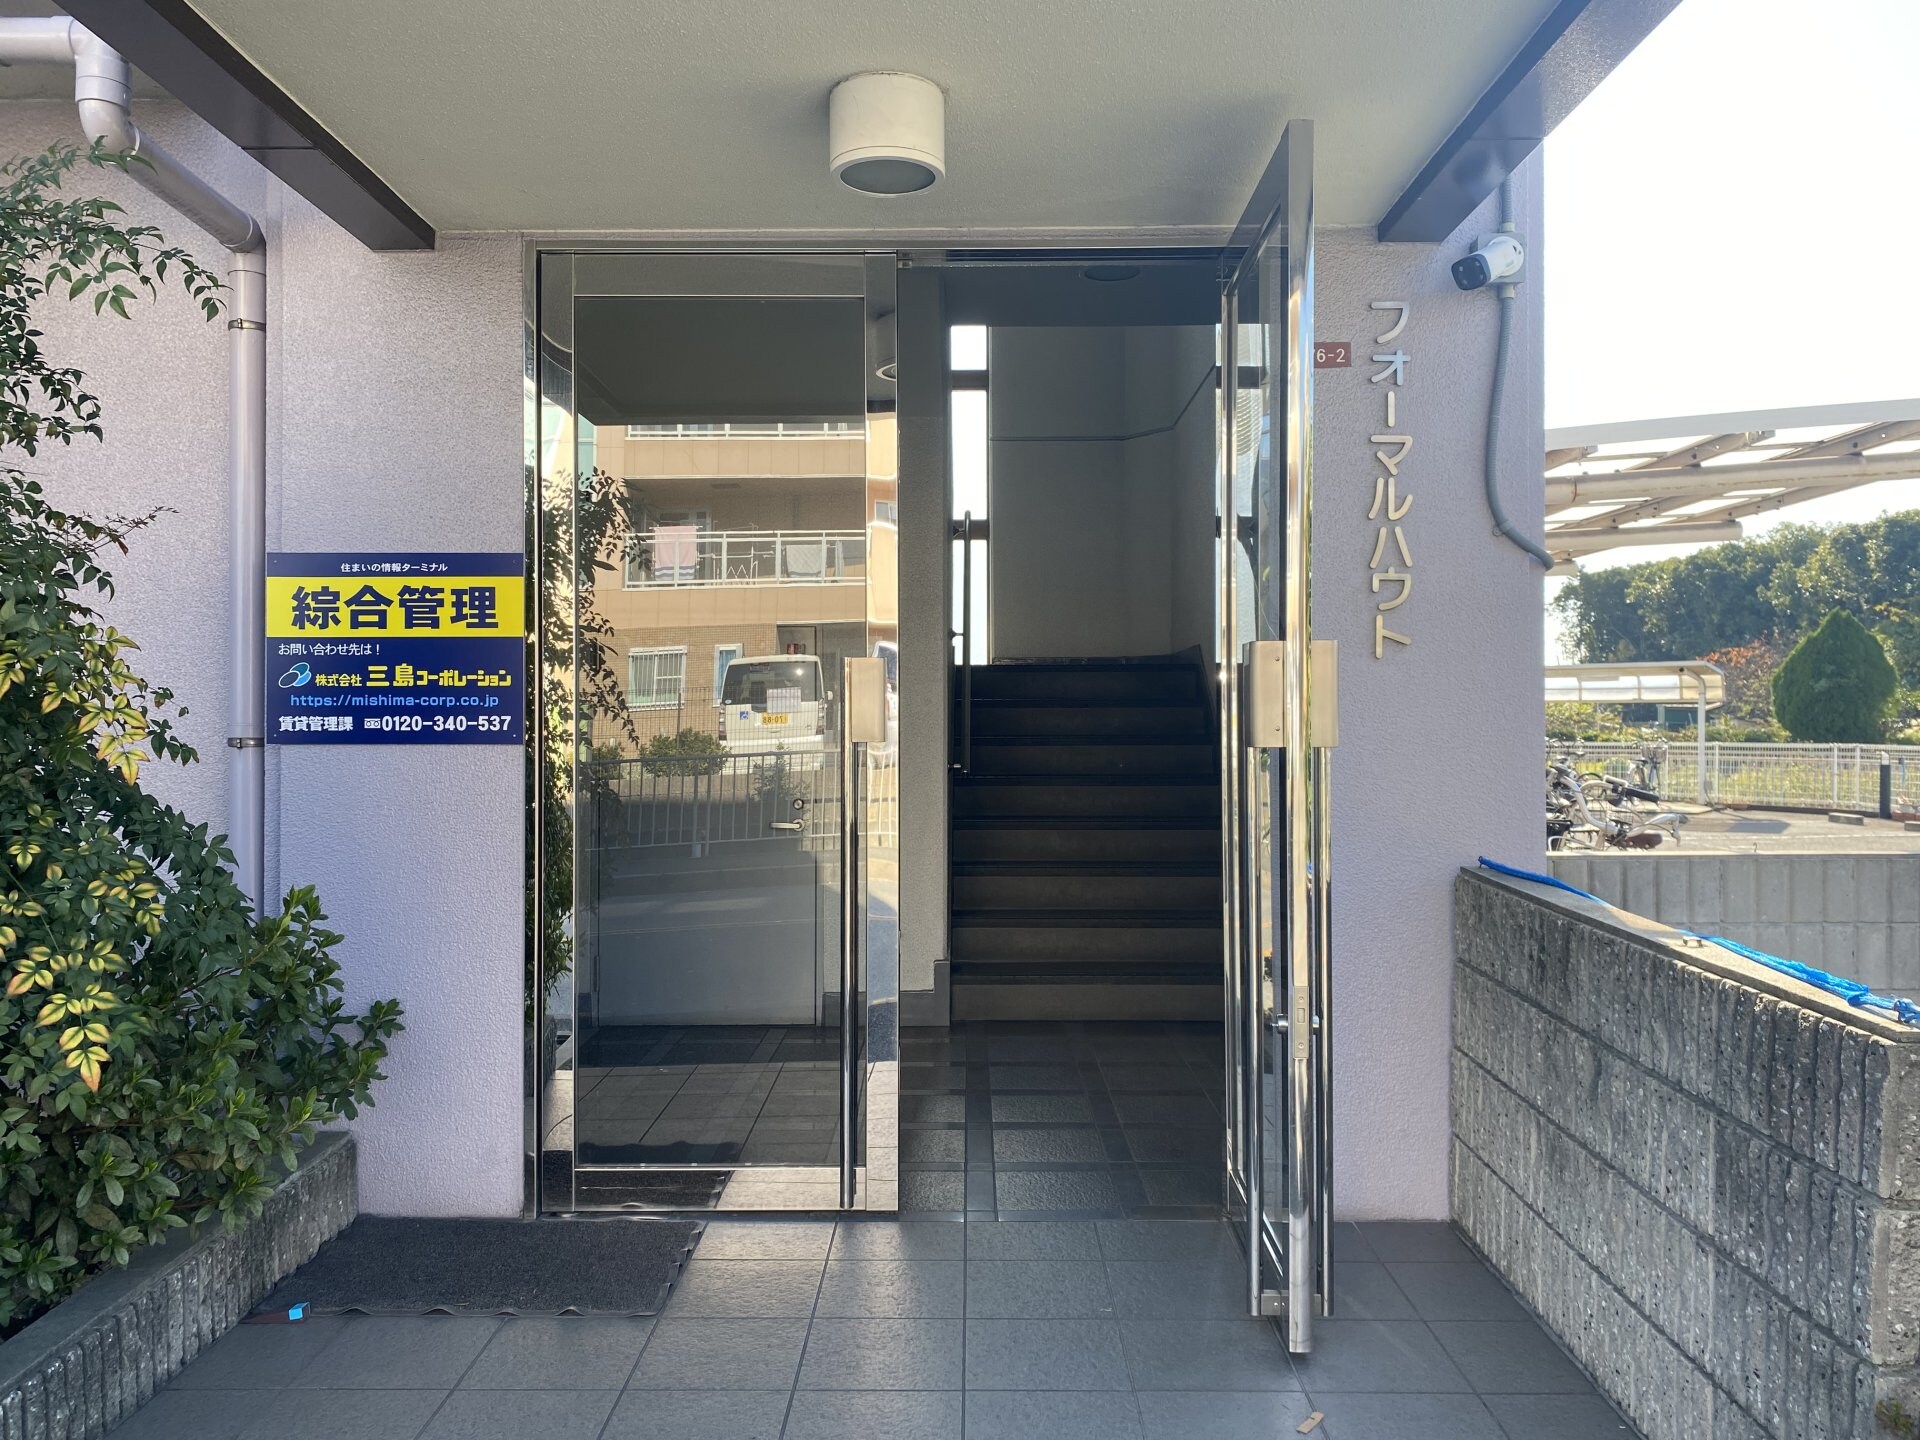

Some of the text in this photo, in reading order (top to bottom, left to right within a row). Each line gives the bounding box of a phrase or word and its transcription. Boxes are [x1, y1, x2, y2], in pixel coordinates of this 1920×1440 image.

[340, 562, 448, 573] 住まいの情報ターミナル
[291, 584, 499, 630] 綜合管理
[290, 694, 499, 708] https://mishima-corp.co.jp
[279, 716, 512, 732] 賃貸管理課 0120-340-537
